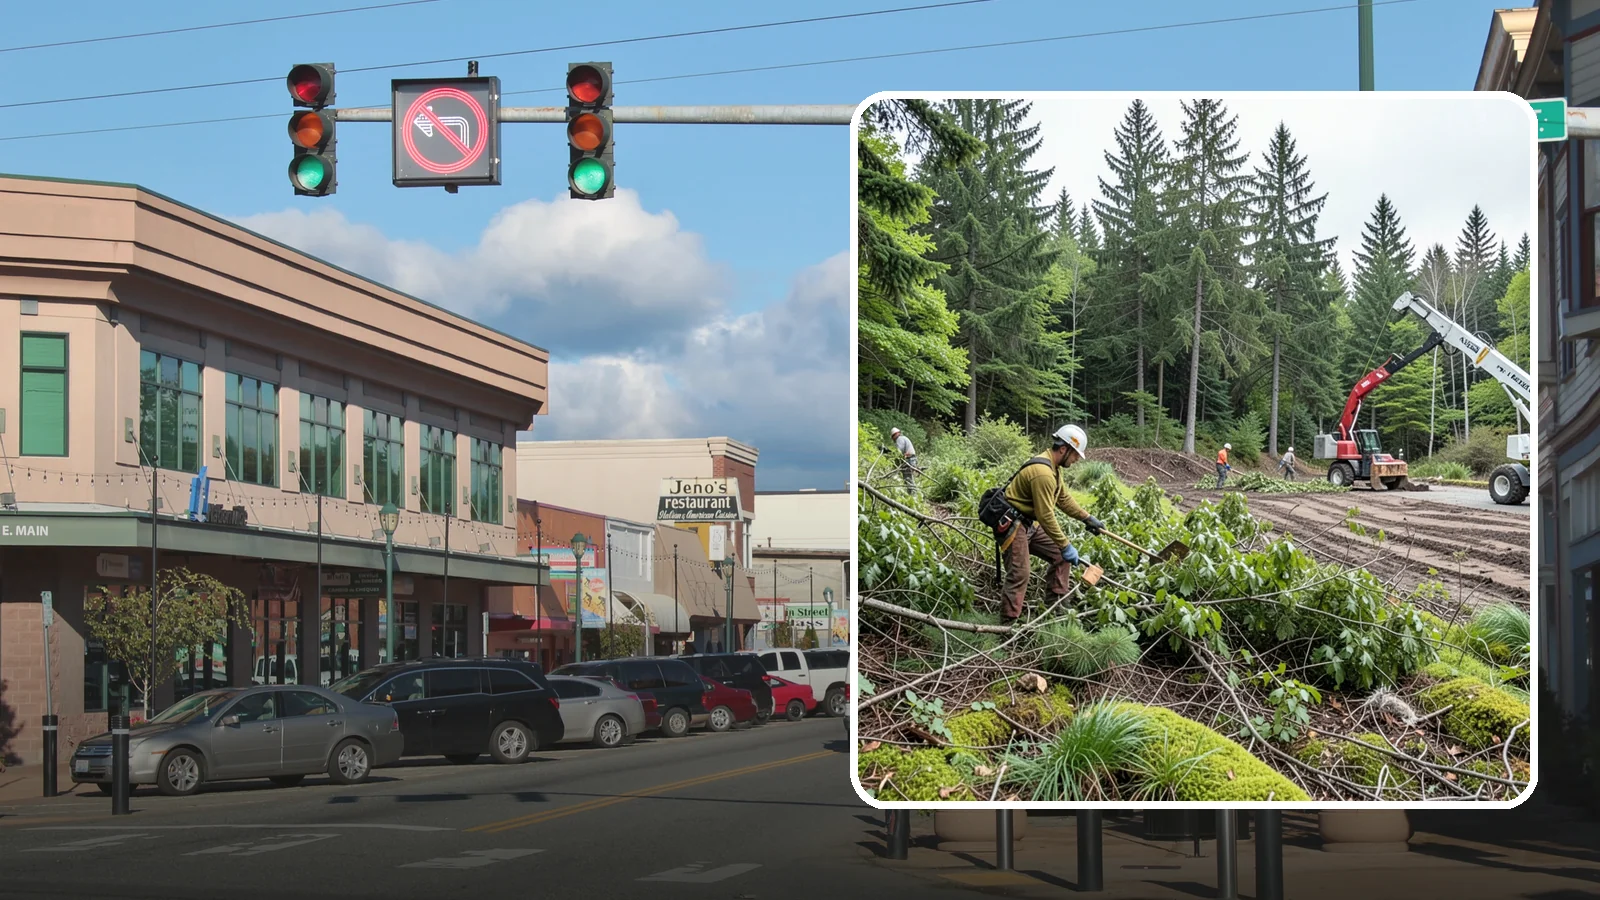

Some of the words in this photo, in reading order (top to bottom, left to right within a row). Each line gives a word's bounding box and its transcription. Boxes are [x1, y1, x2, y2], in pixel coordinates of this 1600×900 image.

[669, 480, 728, 494] Jeno's
[665, 496, 731, 509] restaurant
[686, 509, 714, 519] American
[715, 509, 738, 519] Cuisine
[2, 526, 13, 536] E.
[15, 525, 49, 536] MAIN
[797, 607, 828, 617] Street
[790, 619, 824, 627] lass
